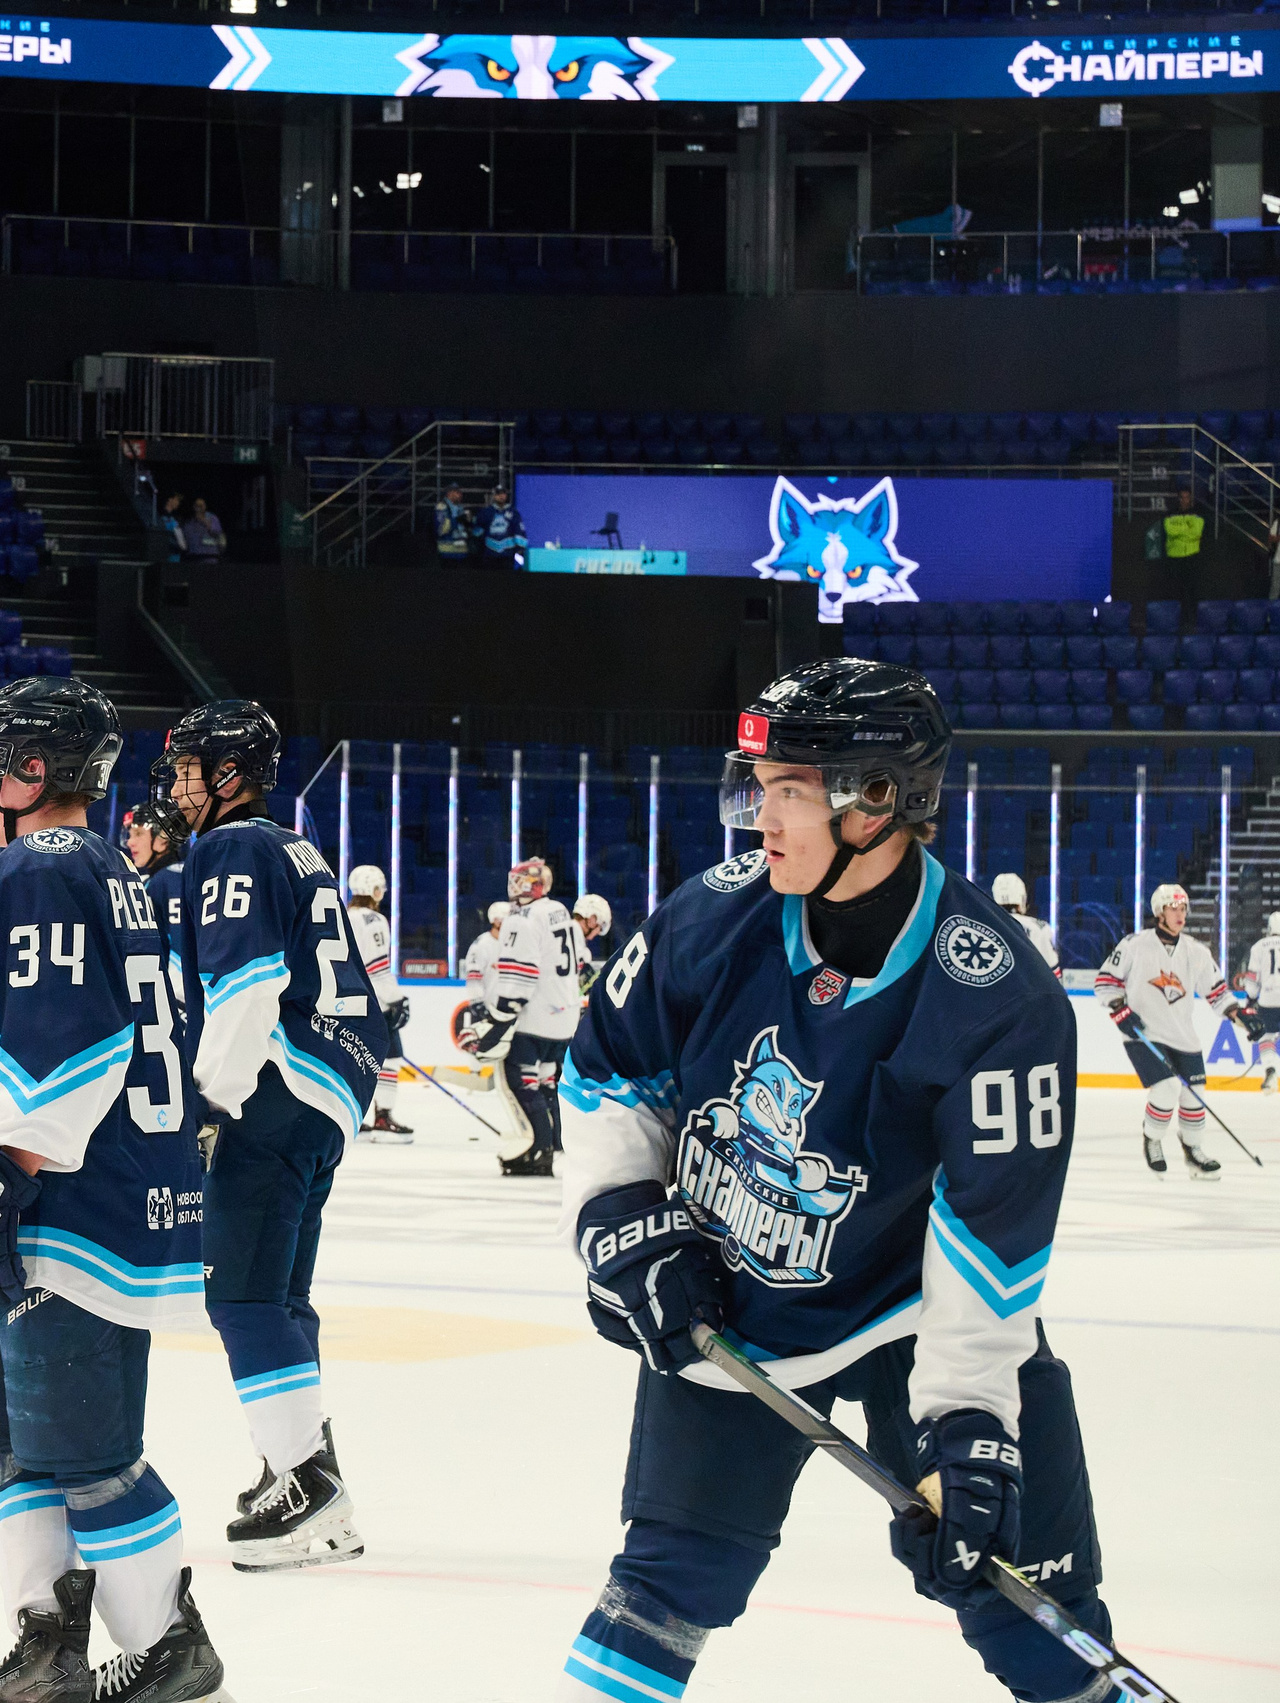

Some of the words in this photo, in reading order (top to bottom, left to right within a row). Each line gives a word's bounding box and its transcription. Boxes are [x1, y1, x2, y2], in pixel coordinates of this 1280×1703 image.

[1061, 35, 1241, 50] СИБИРСКИЕ
[201, 874, 253, 926] 26
[8, 922, 86, 988] 34
[821, 974, 841, 989] МХЛ
[970, 1062, 1063, 1155] 98
[725, 1147, 789, 1206] СИБИРСКИЕ
[596, 1209, 696, 1268] BAUE
[6, 1288, 57, 1326] BAUE
[1013, 1552, 1074, 1584] CM
